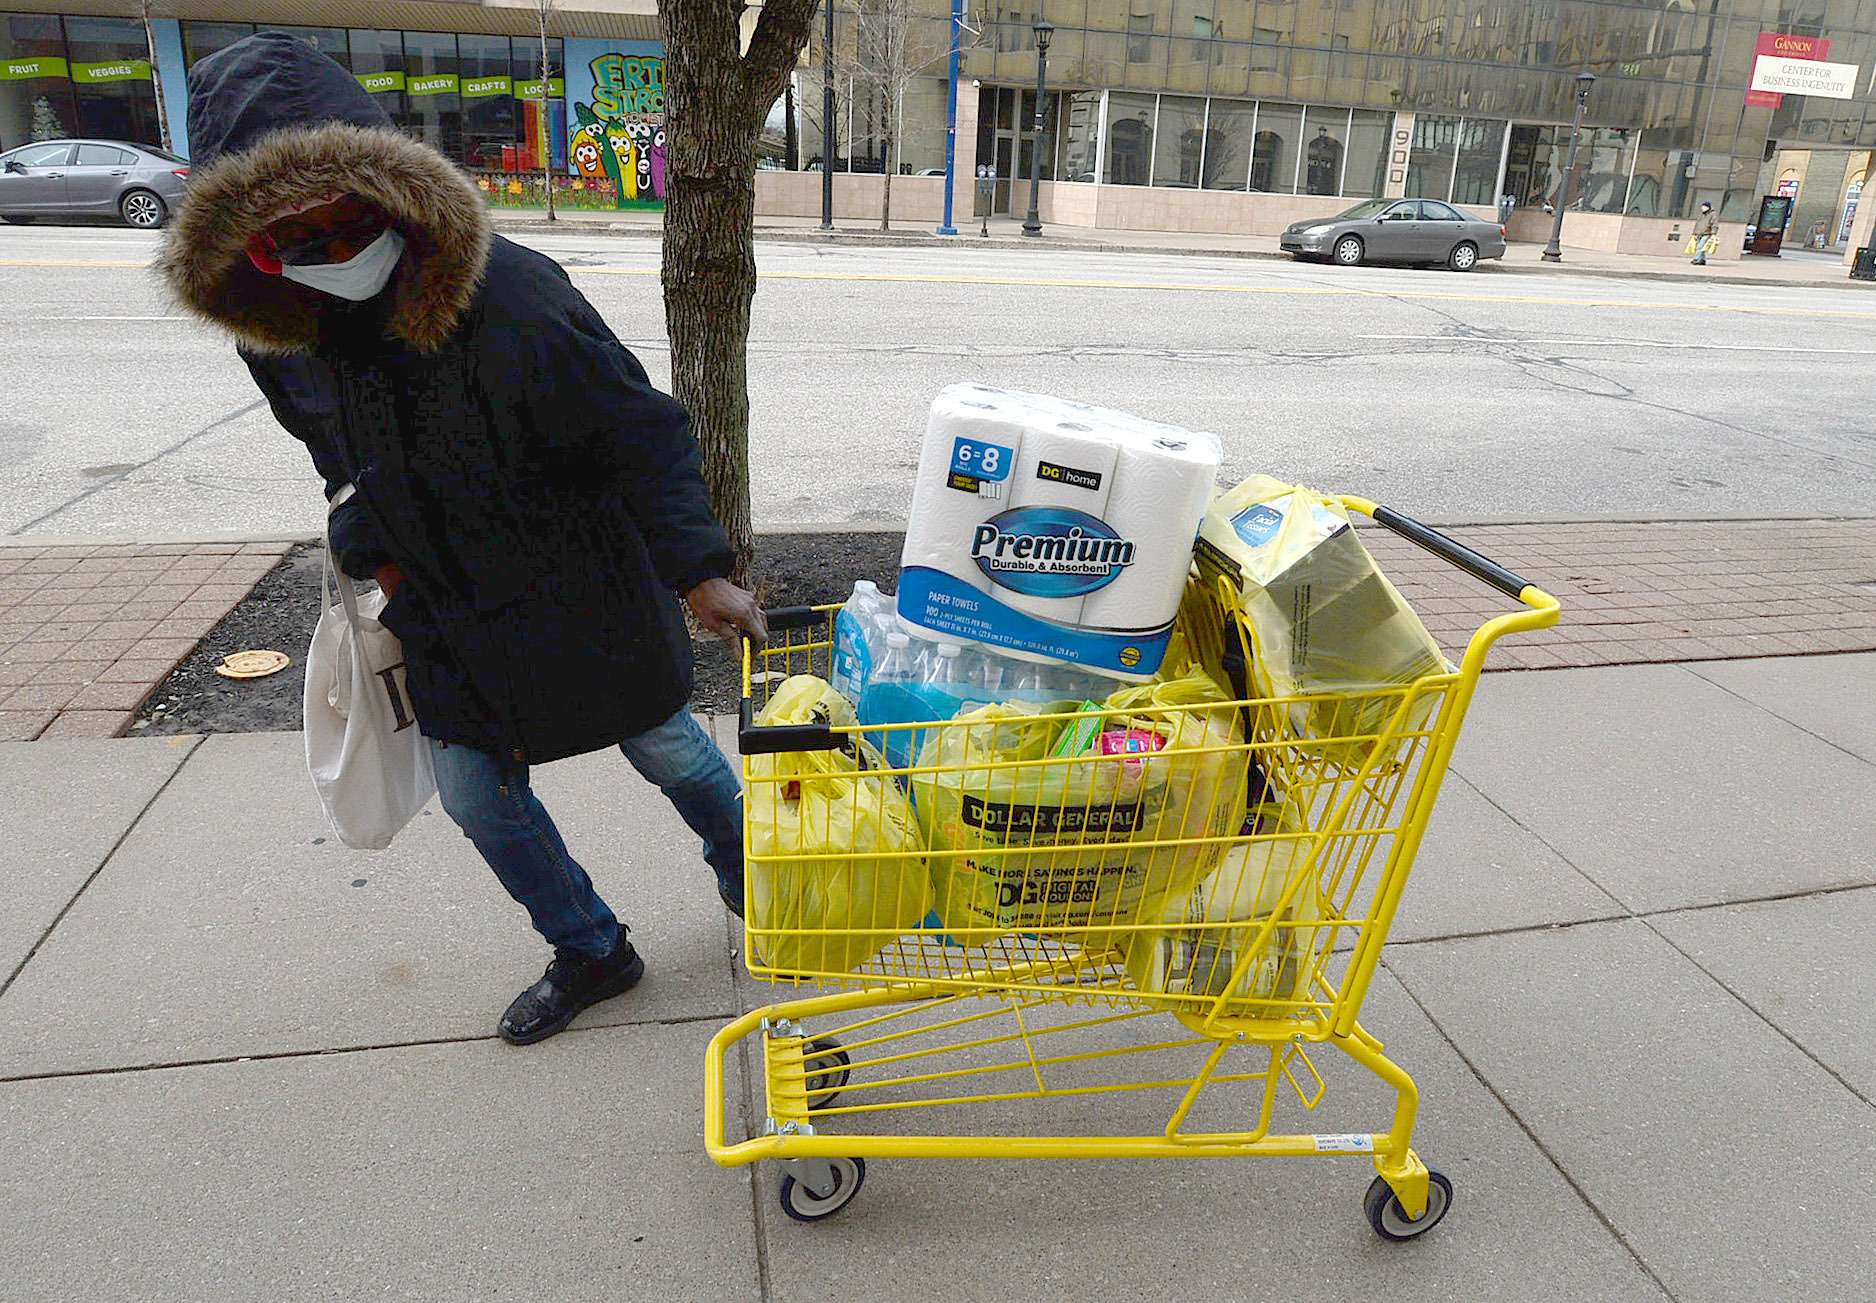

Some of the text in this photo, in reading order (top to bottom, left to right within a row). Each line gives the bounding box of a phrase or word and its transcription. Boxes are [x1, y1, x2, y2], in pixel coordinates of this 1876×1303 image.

[1775, 37, 1812, 52] GANNON
[9, 63, 39, 74] FRUIT
[88, 66, 132, 78] VEGGIES
[591, 54, 666, 90] ERI
[1782, 64, 1832, 79] CENTER FOR
[365, 76, 393, 88] FOOD
[413, 79, 454, 91] BAKERY
[467, 81, 506, 93] CRAFTS
[524, 84, 556, 95] LOCL
[1763, 75, 1846, 92] BUSINESS INGENUITY
[592, 86, 665, 121] STRO
[1391, 130, 1409, 183] 900
[1041, 465, 1097, 487] DG home
[971, 525, 1134, 563] Premium
[992, 559, 1108, 573] Durable & Absorbent
[928, 591, 979, 611] PAPER TOWELS
[926, 604, 939, 617] 100
[995, 881, 1038, 907] DG
